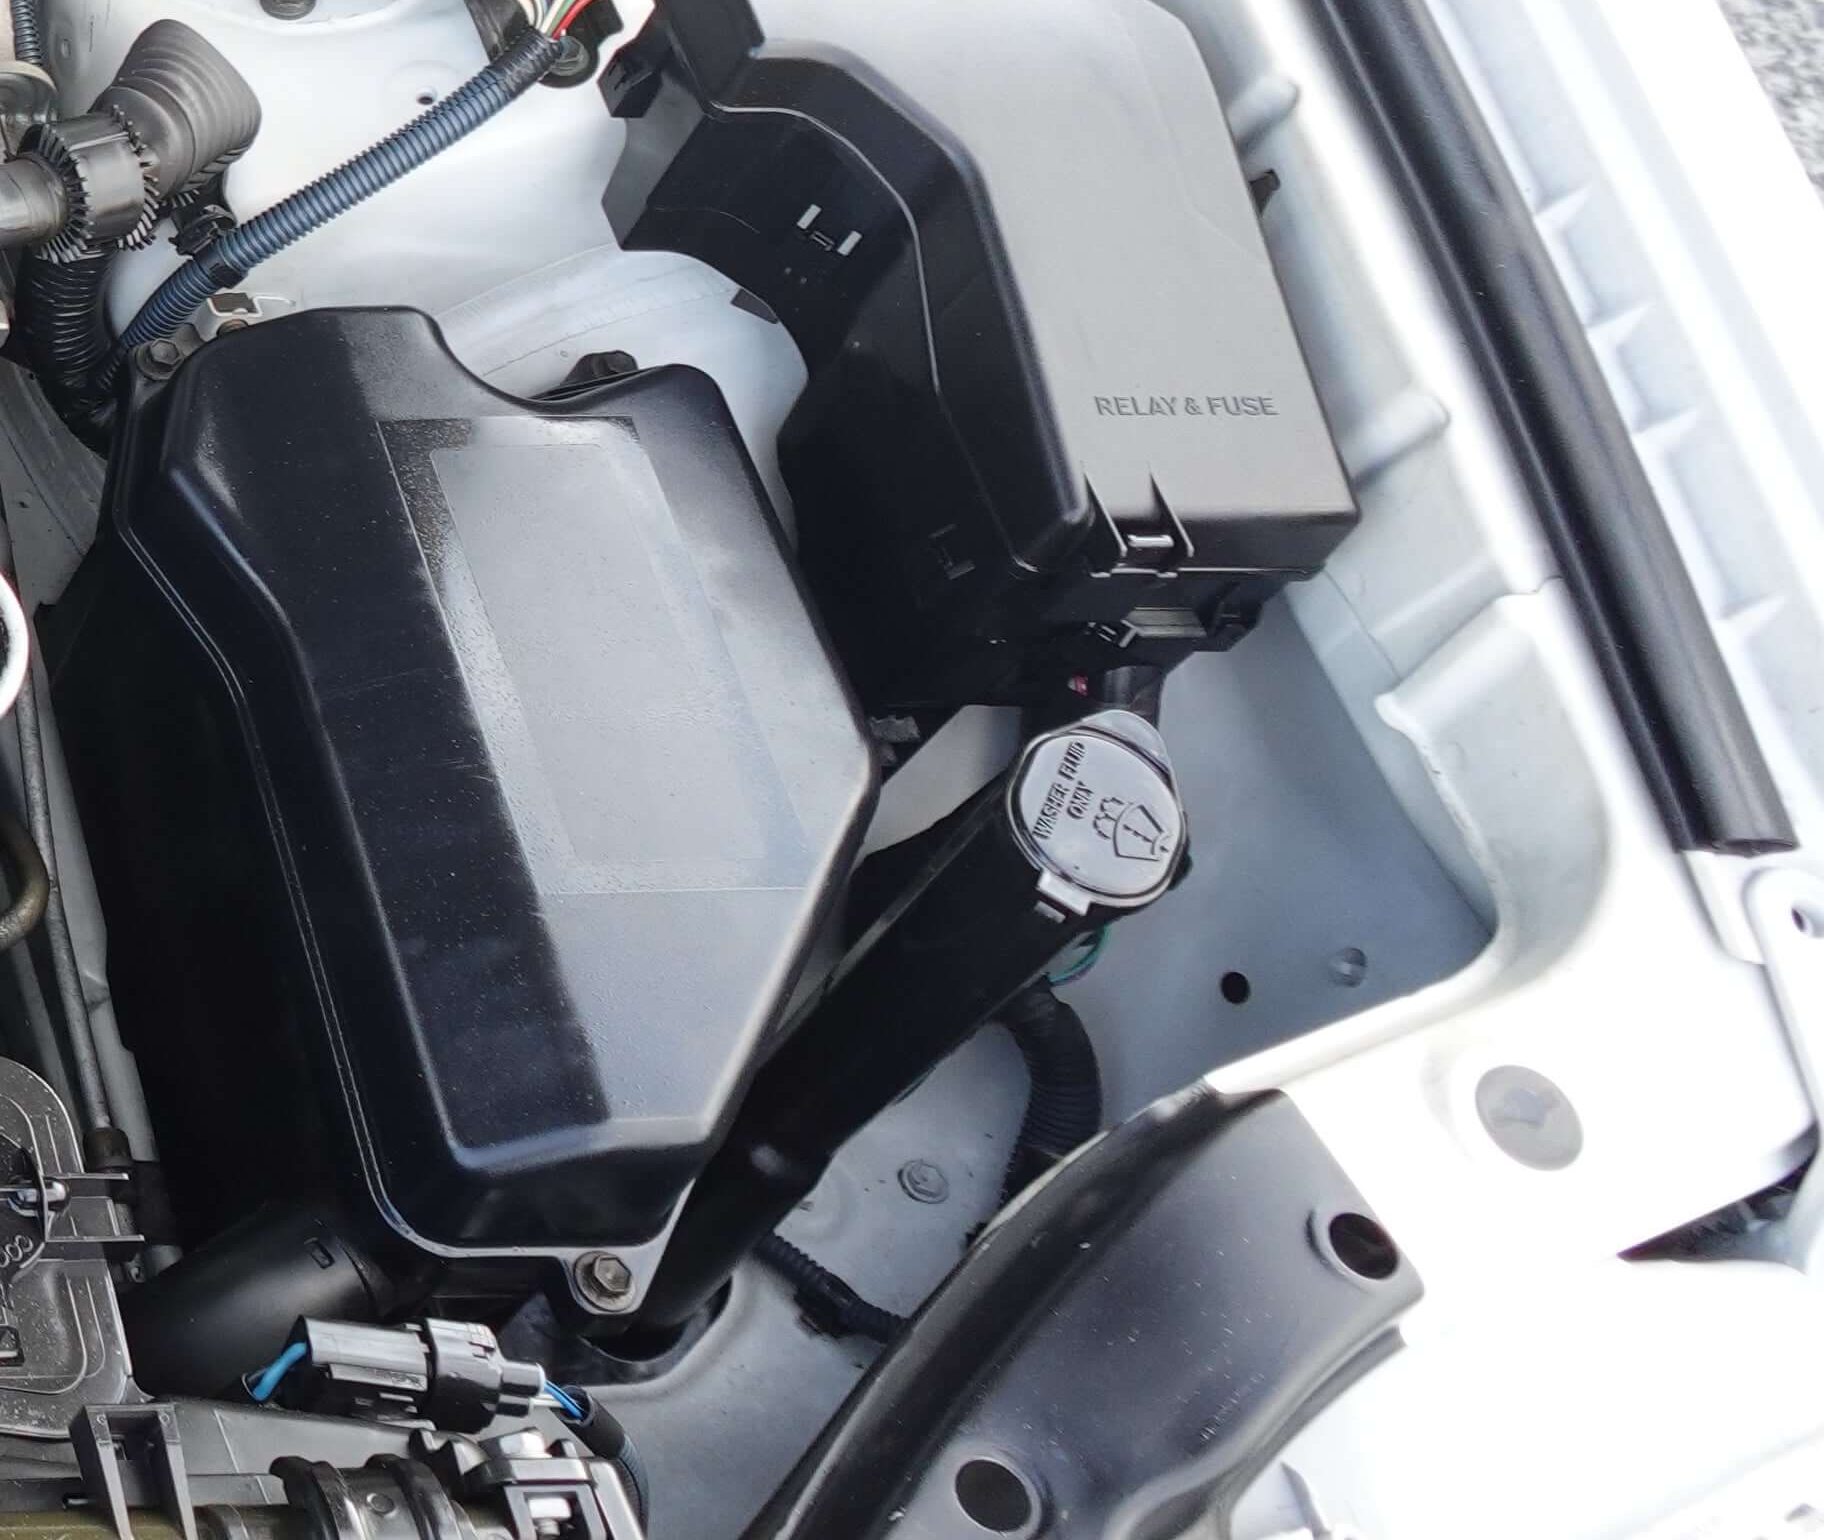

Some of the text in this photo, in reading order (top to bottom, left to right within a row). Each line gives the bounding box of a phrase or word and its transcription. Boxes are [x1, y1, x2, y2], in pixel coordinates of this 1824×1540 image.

[1093, 395, 1281, 417] RELAY & FUSE
[1031, 739, 1087, 841] WASHER FLUID
[1065, 780, 1095, 821] ONLY
